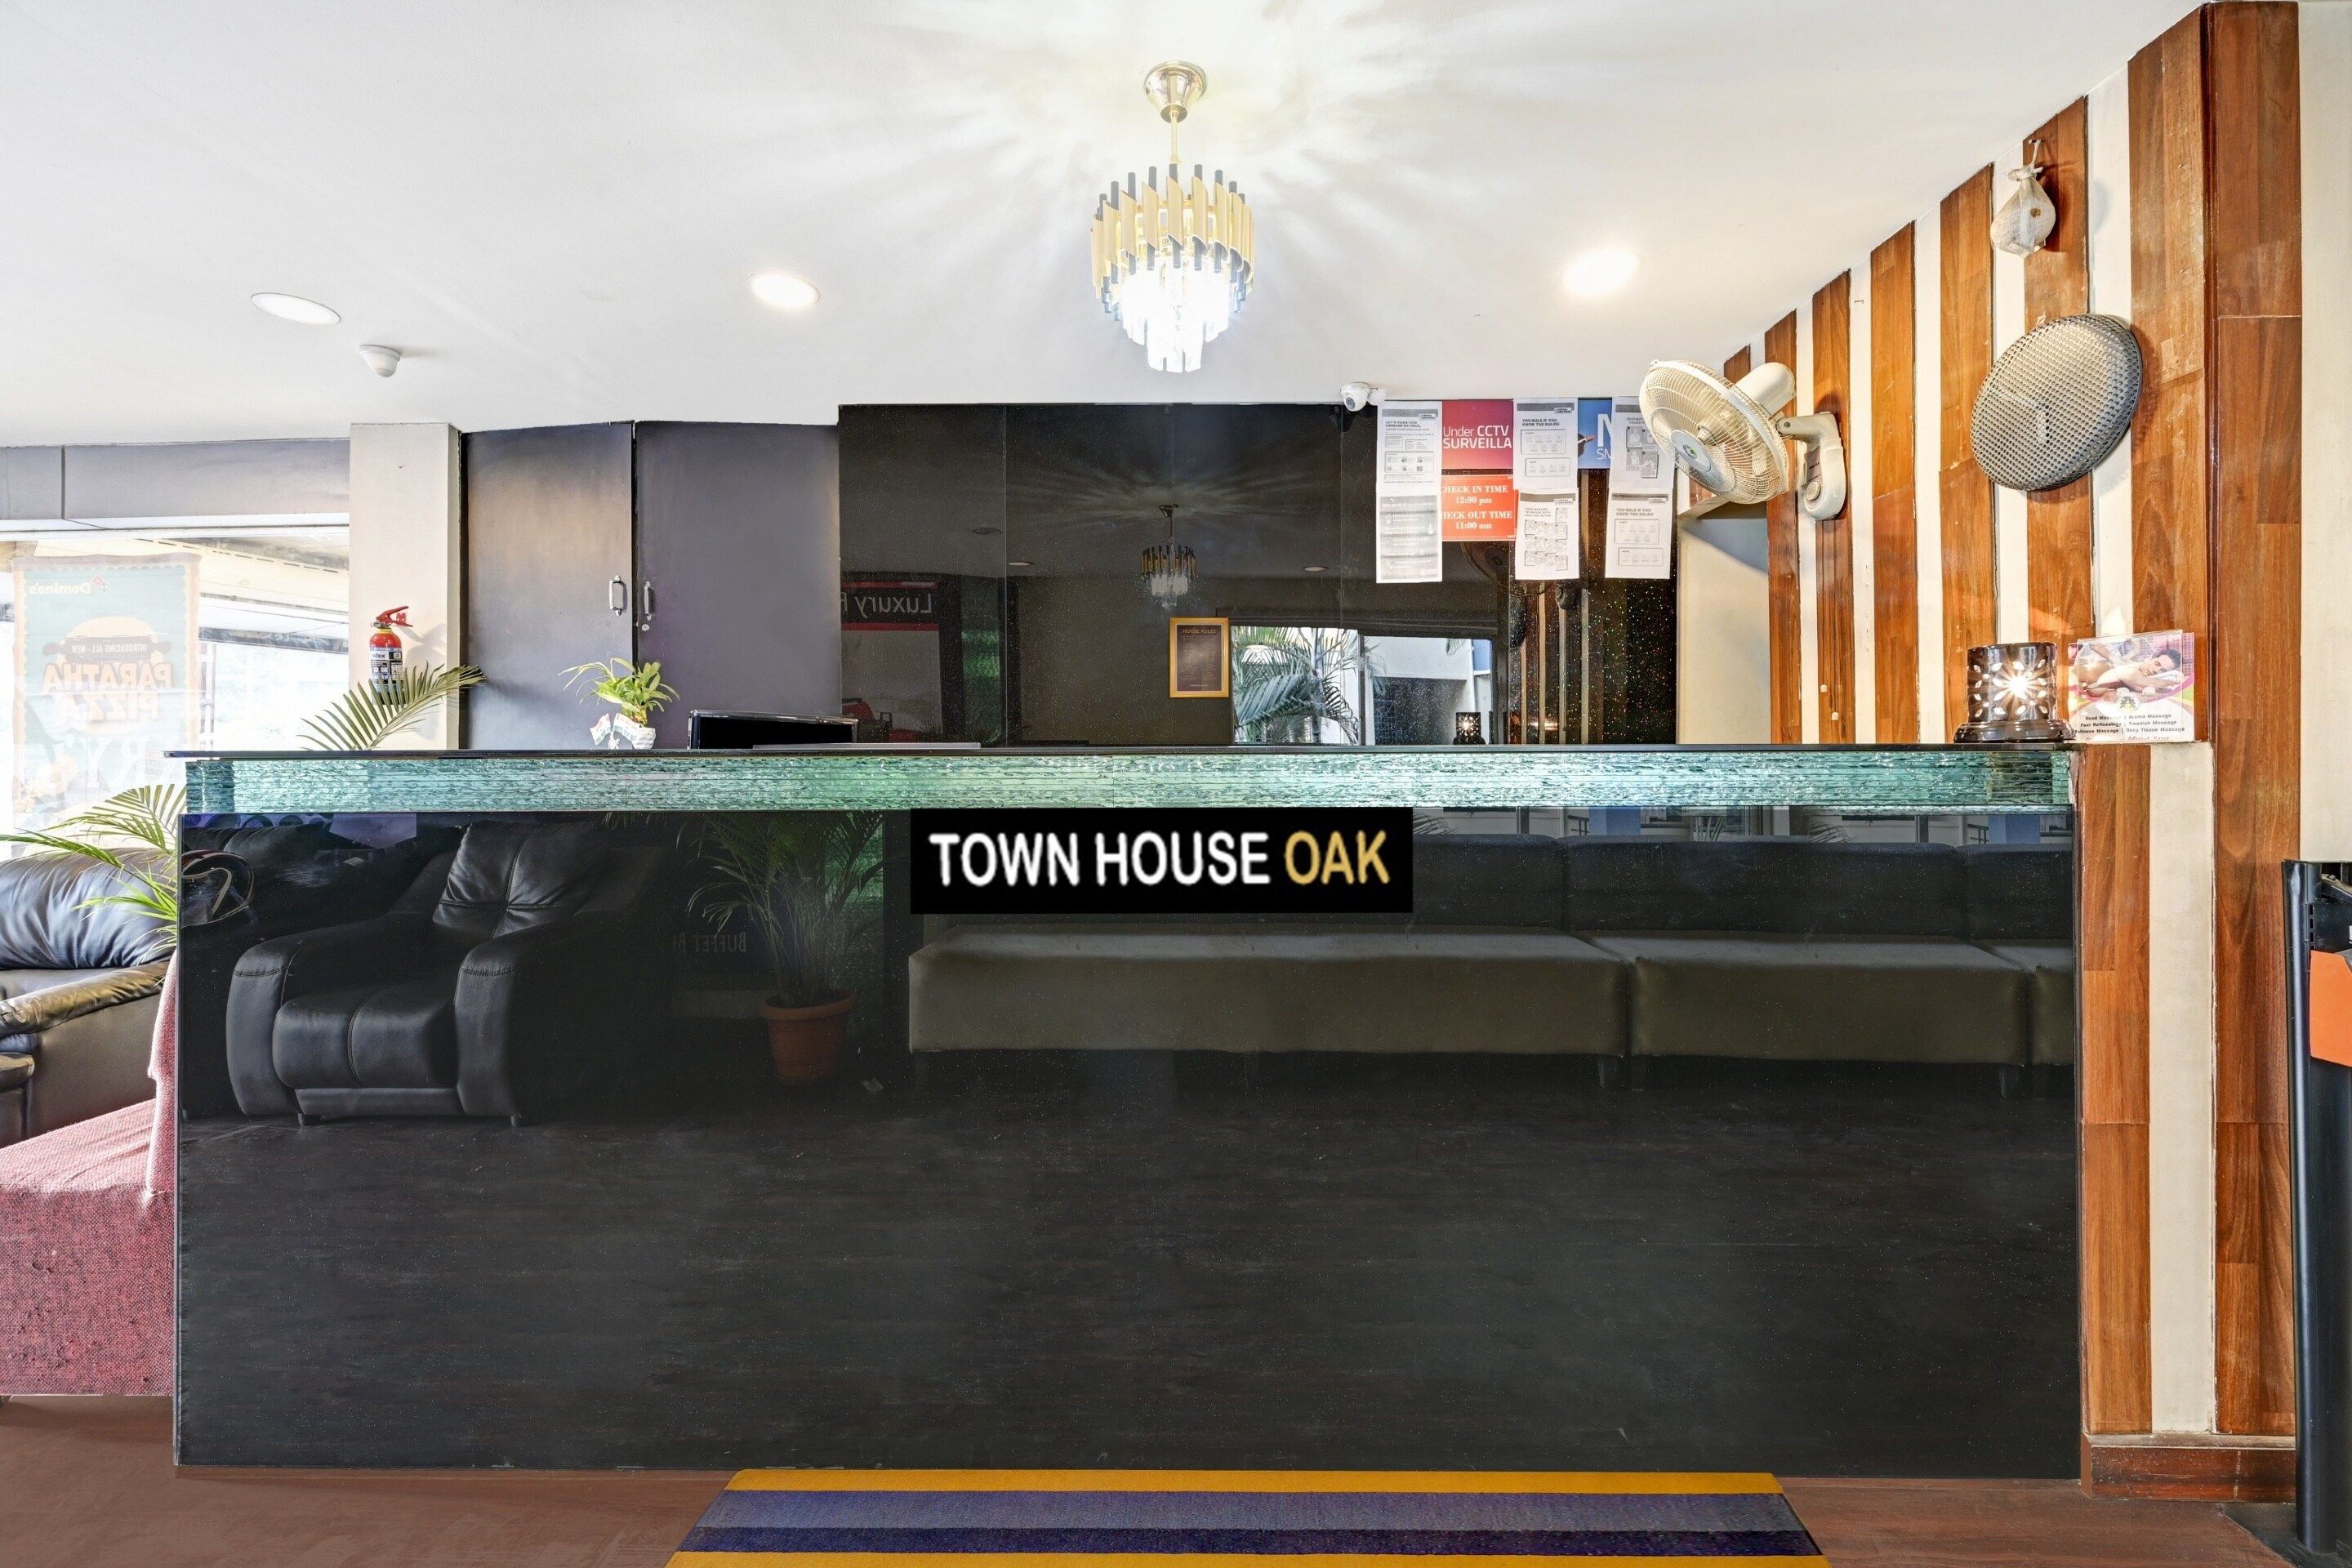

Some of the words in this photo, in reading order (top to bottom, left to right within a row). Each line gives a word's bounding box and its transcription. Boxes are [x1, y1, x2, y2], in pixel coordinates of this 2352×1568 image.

[1443, 425, 1474, 437] Under
[1477, 425, 1509, 437] CCTV
[1442, 437, 1512, 449] SURVEILLA
[1472, 485, 1482, 493] IN
[1484, 484, 1509, 493] TIME
[1455, 496, 1477, 504] 12:00
[1478, 498, 1492, 506] pm
[1468, 510, 1486, 519] OUT
[1489, 510, 1513, 519] TIME
[1455, 521, 1477, 529] 11:00
[928, 831, 1080, 887] TOWN
[1095, 831, 1271, 886] HOUSE
[1284, 829, 1391, 885] OAK
